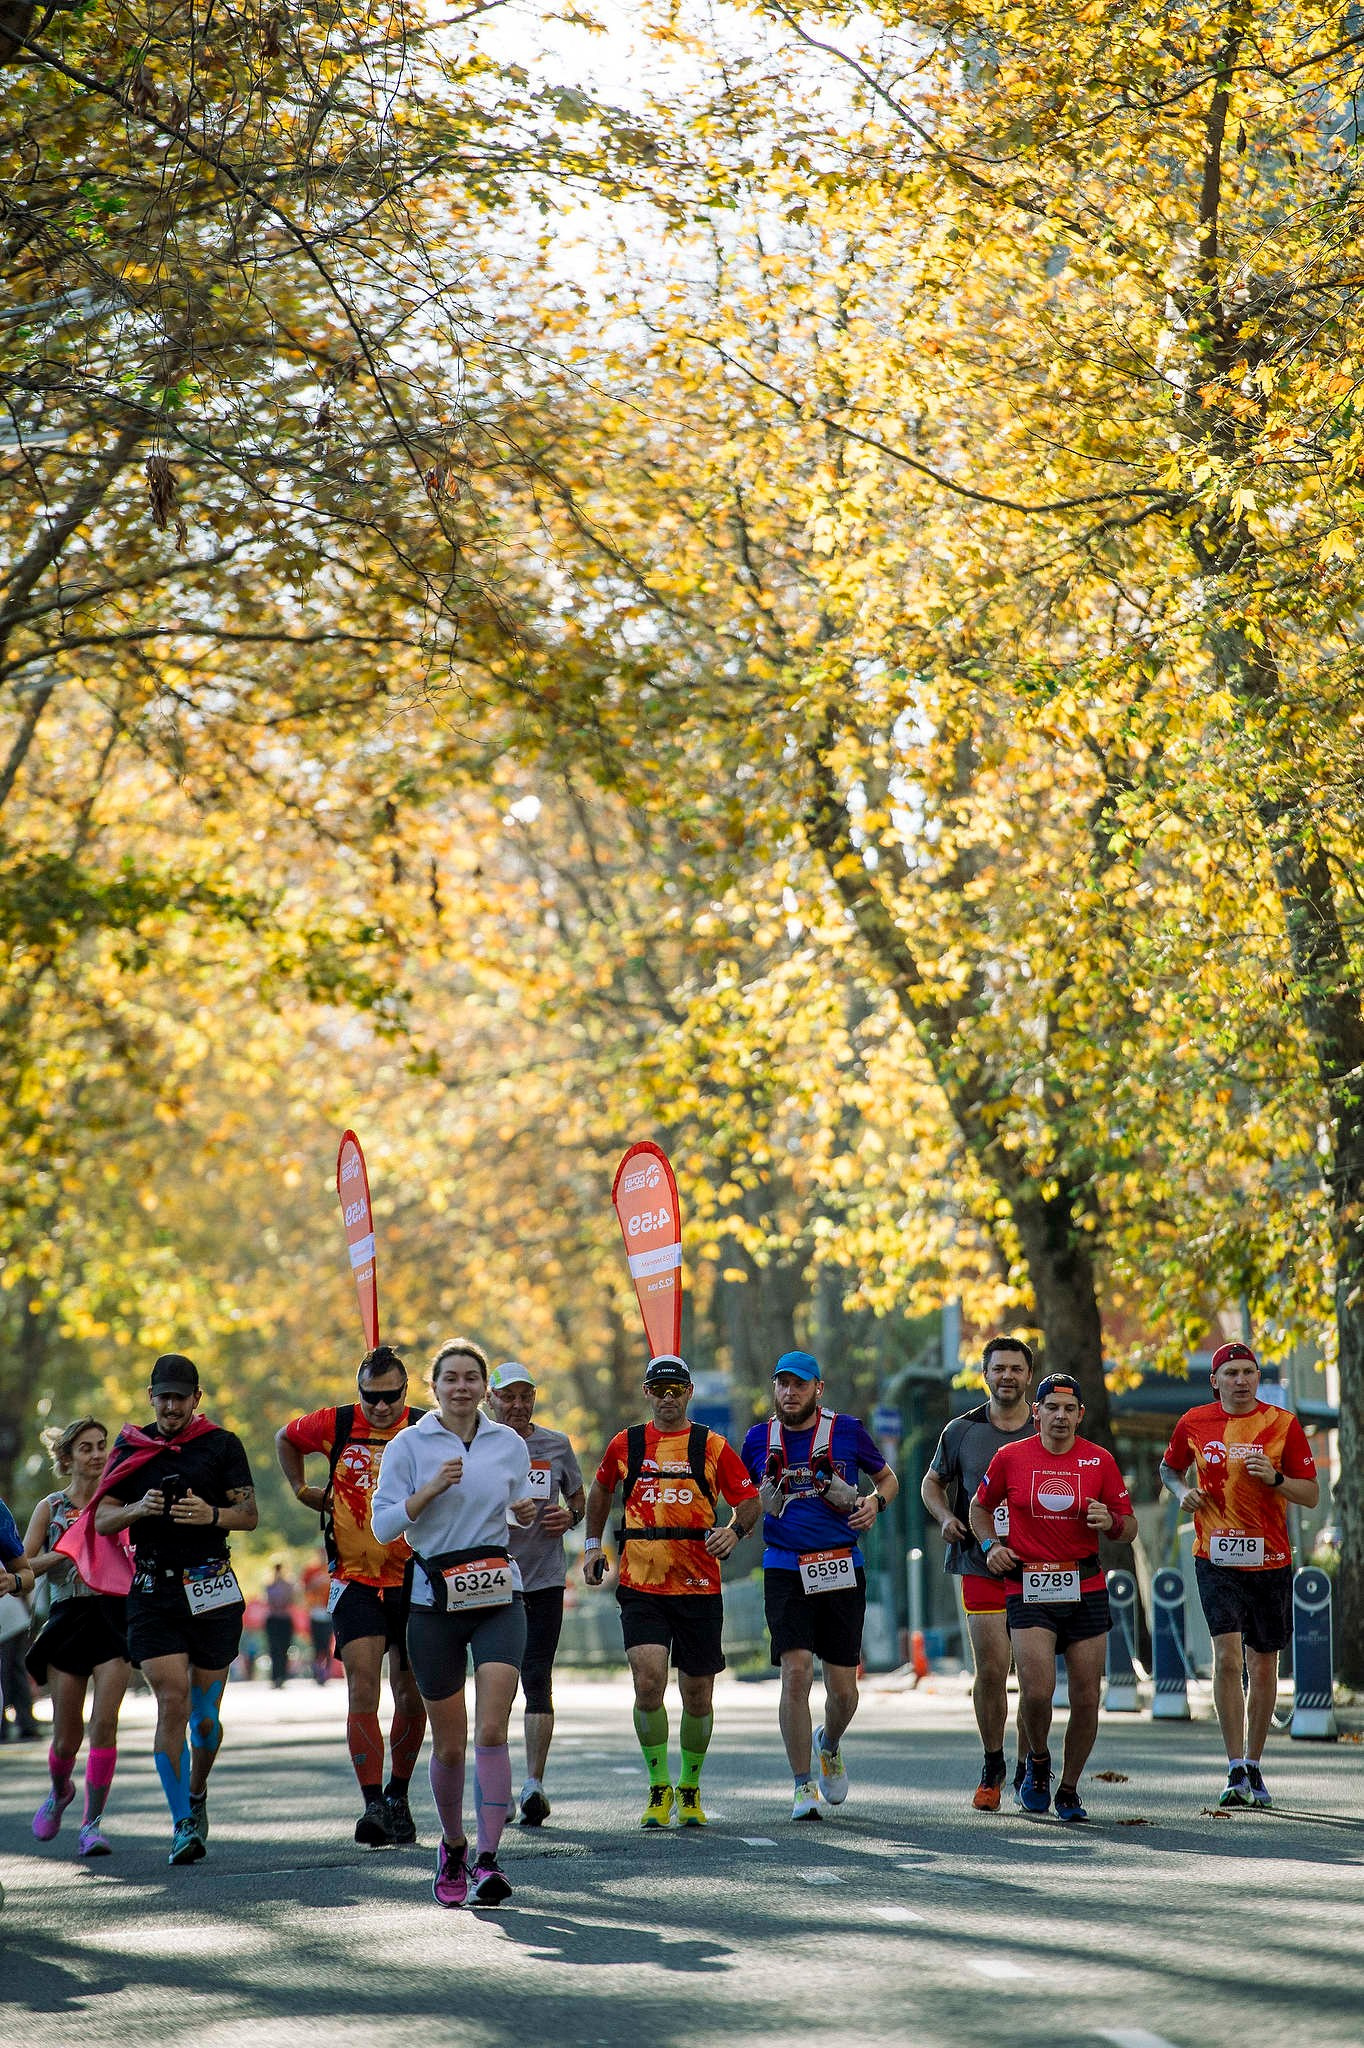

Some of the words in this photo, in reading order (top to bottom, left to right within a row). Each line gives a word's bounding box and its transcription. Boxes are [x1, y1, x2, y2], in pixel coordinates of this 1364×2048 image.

[641, 1488, 693, 1505] 4:59
[1218, 1538, 1257, 1552] 6718
[807, 1560, 849, 1578] 6598
[193, 1575, 233, 1597] 6546
[454, 1570, 506, 1592] 6324
[1029, 1572, 1074, 1587] 6789
